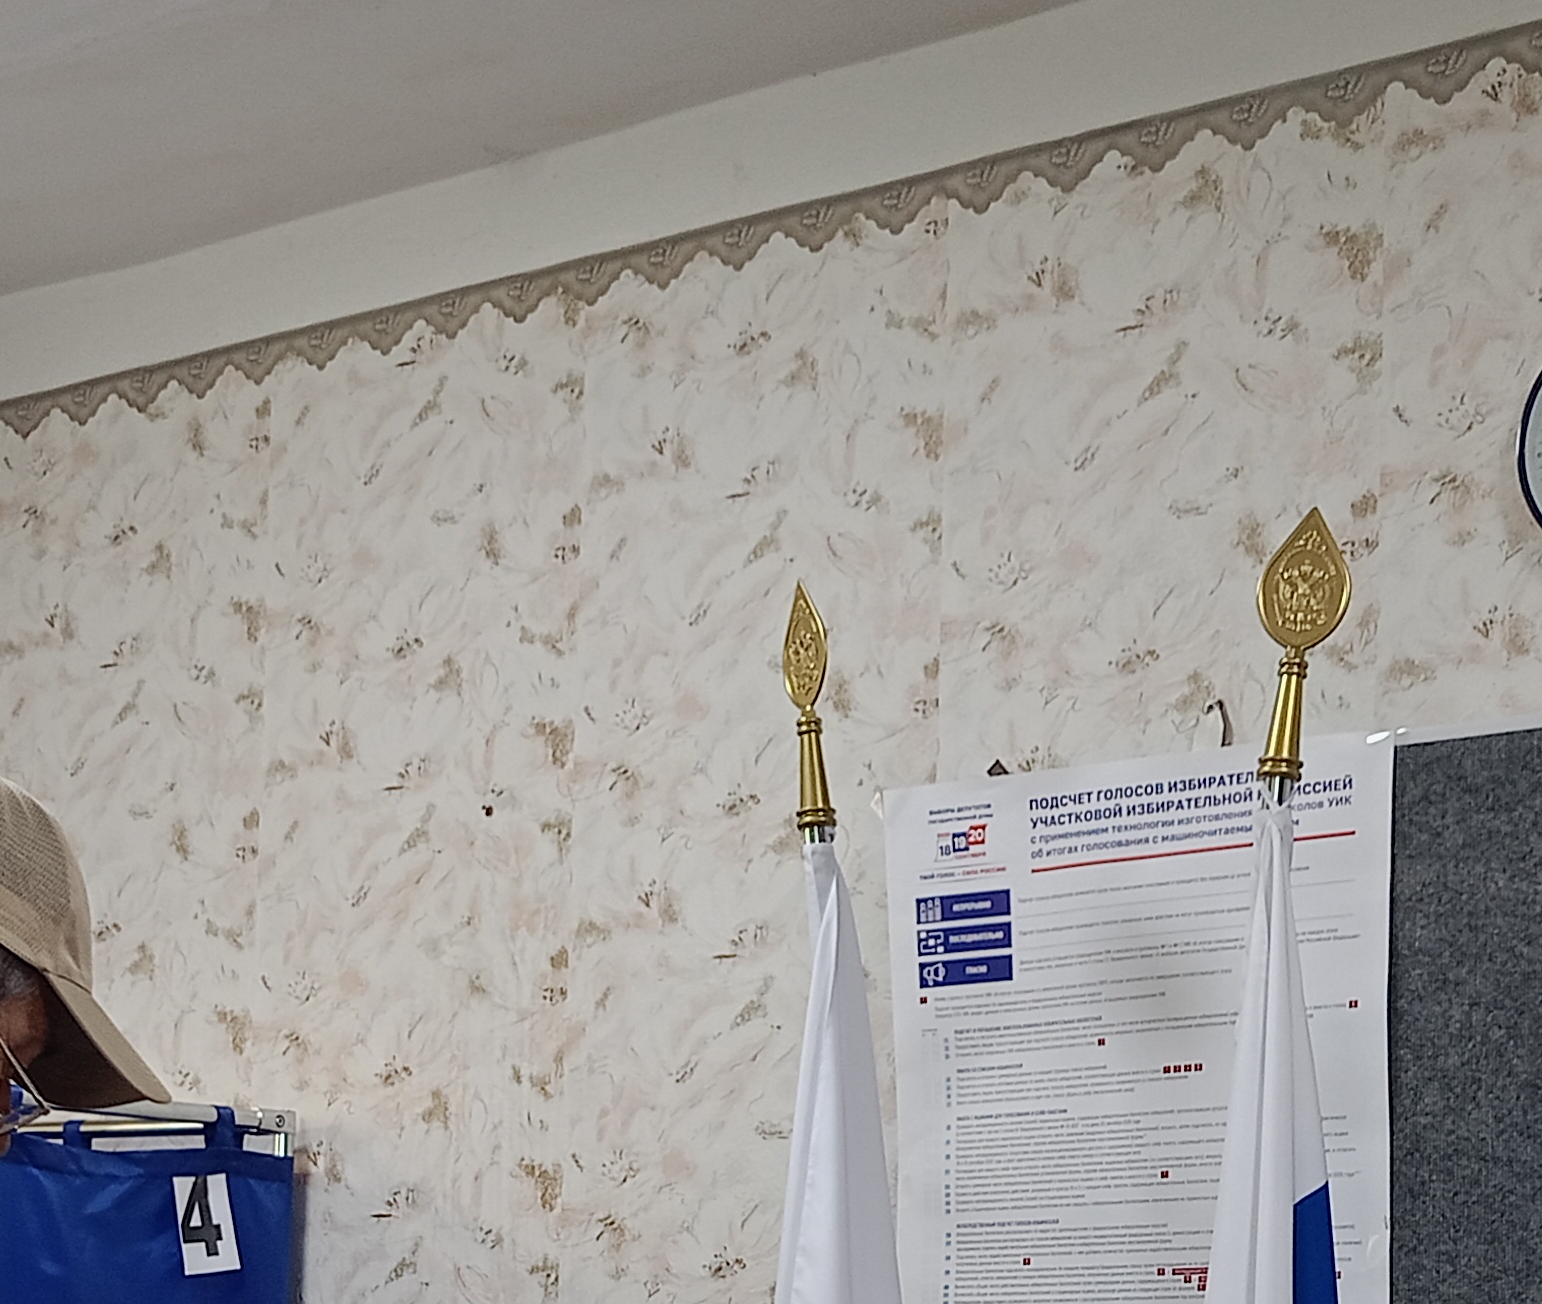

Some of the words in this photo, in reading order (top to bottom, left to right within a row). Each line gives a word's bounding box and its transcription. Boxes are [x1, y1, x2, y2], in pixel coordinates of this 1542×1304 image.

[1029, 792, 1093, 811] ПОДСЧЕТ
[1097, 783, 1164, 801] ГОЛОСОВ
[1168, 771, 1254, 793] ИЗБИРАТЕЛ
[1031, 806, 1123, 829] УЧАСТКОВОЙ
[1126, 790, 1253, 816] ИЗБИРАТЕЛЬНОЙ
[1031, 835, 1037, 844] с
[1039, 826, 1109, 844] применением
[1111, 818, 1175, 834] технологии
[1177, 808, 1253, 826] изготовления
[1327, 795, 1352, 811] УИК
[940, 845, 951, 856] 18
[954, 836, 966, 849] 19
[968, 828, 984, 842] 20
[1031, 847, 1044, 858] об
[1046, 845, 1078, 857] итогах
[1081, 836, 1149, 854] голосования
[1161, 824, 1253, 844] машиночитаемы
[181, 1175, 223, 1257] 4
